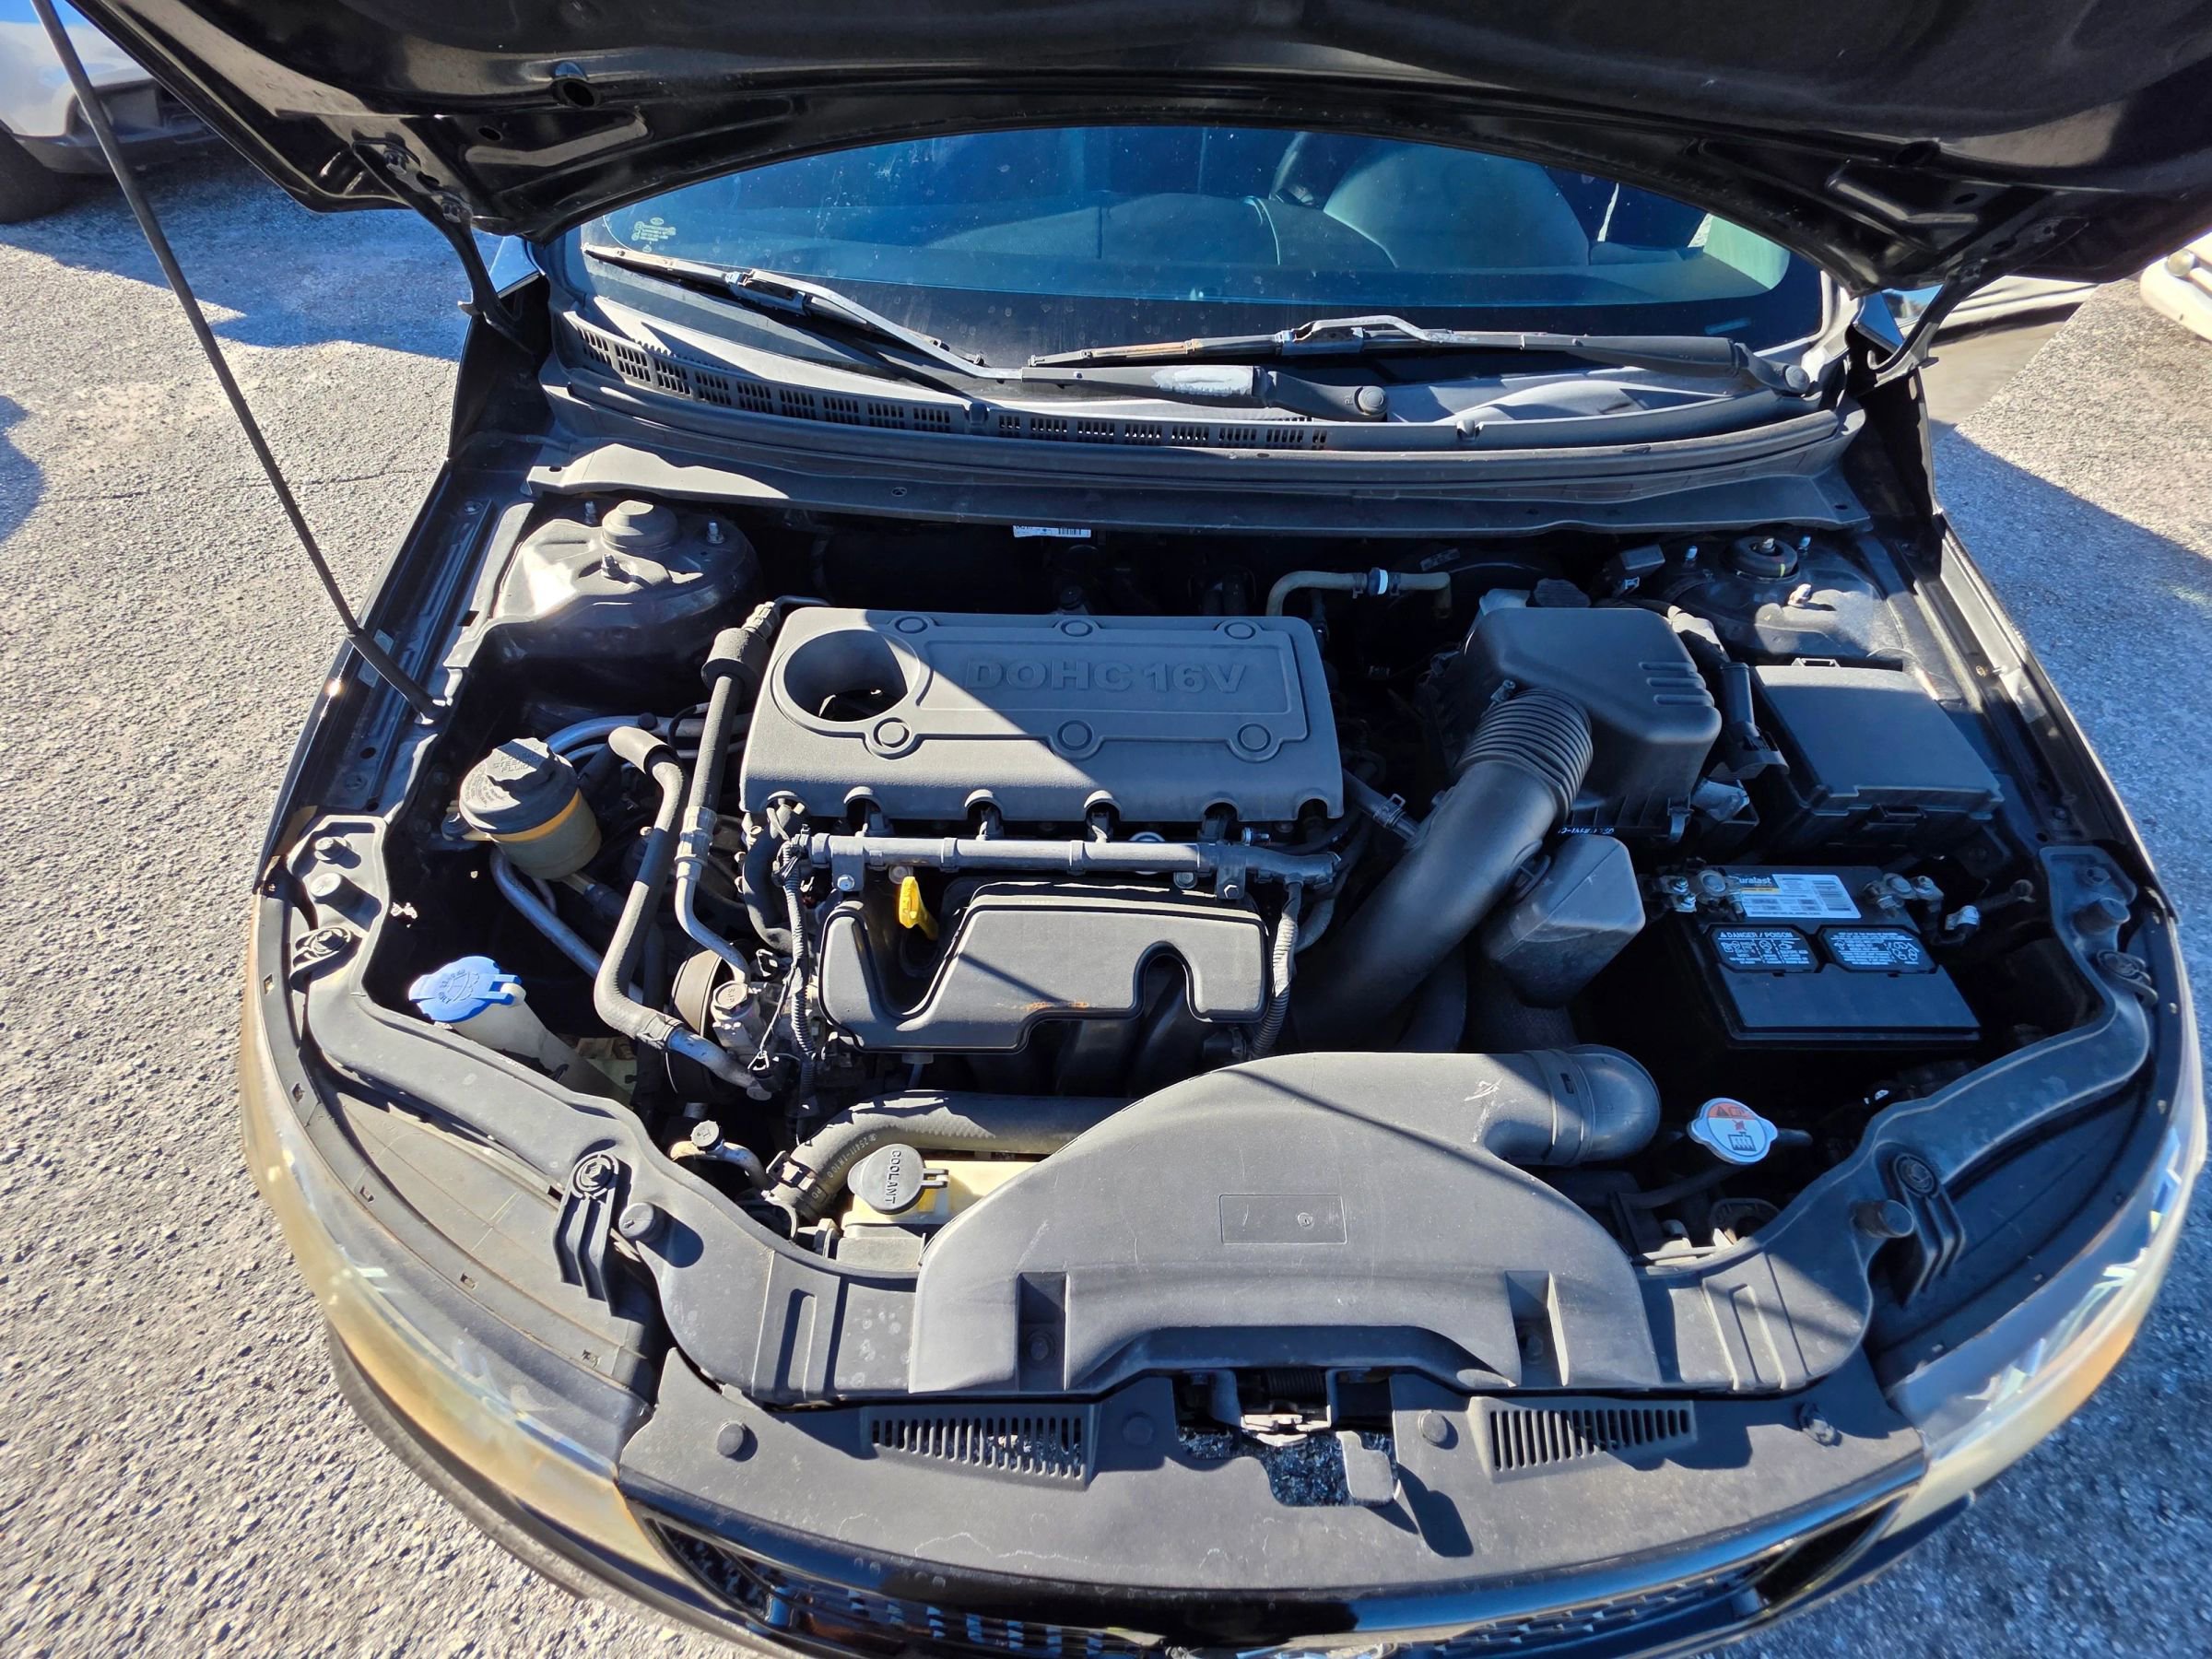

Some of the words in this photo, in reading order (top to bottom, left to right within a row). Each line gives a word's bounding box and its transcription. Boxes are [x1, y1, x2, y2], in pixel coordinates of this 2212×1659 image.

[966, 657, 1134, 692] DOHC
[1141, 662, 1248, 694] 16V
[1738, 876, 1771, 884] uralast
[885, 1149, 901, 1205] COOLANT
